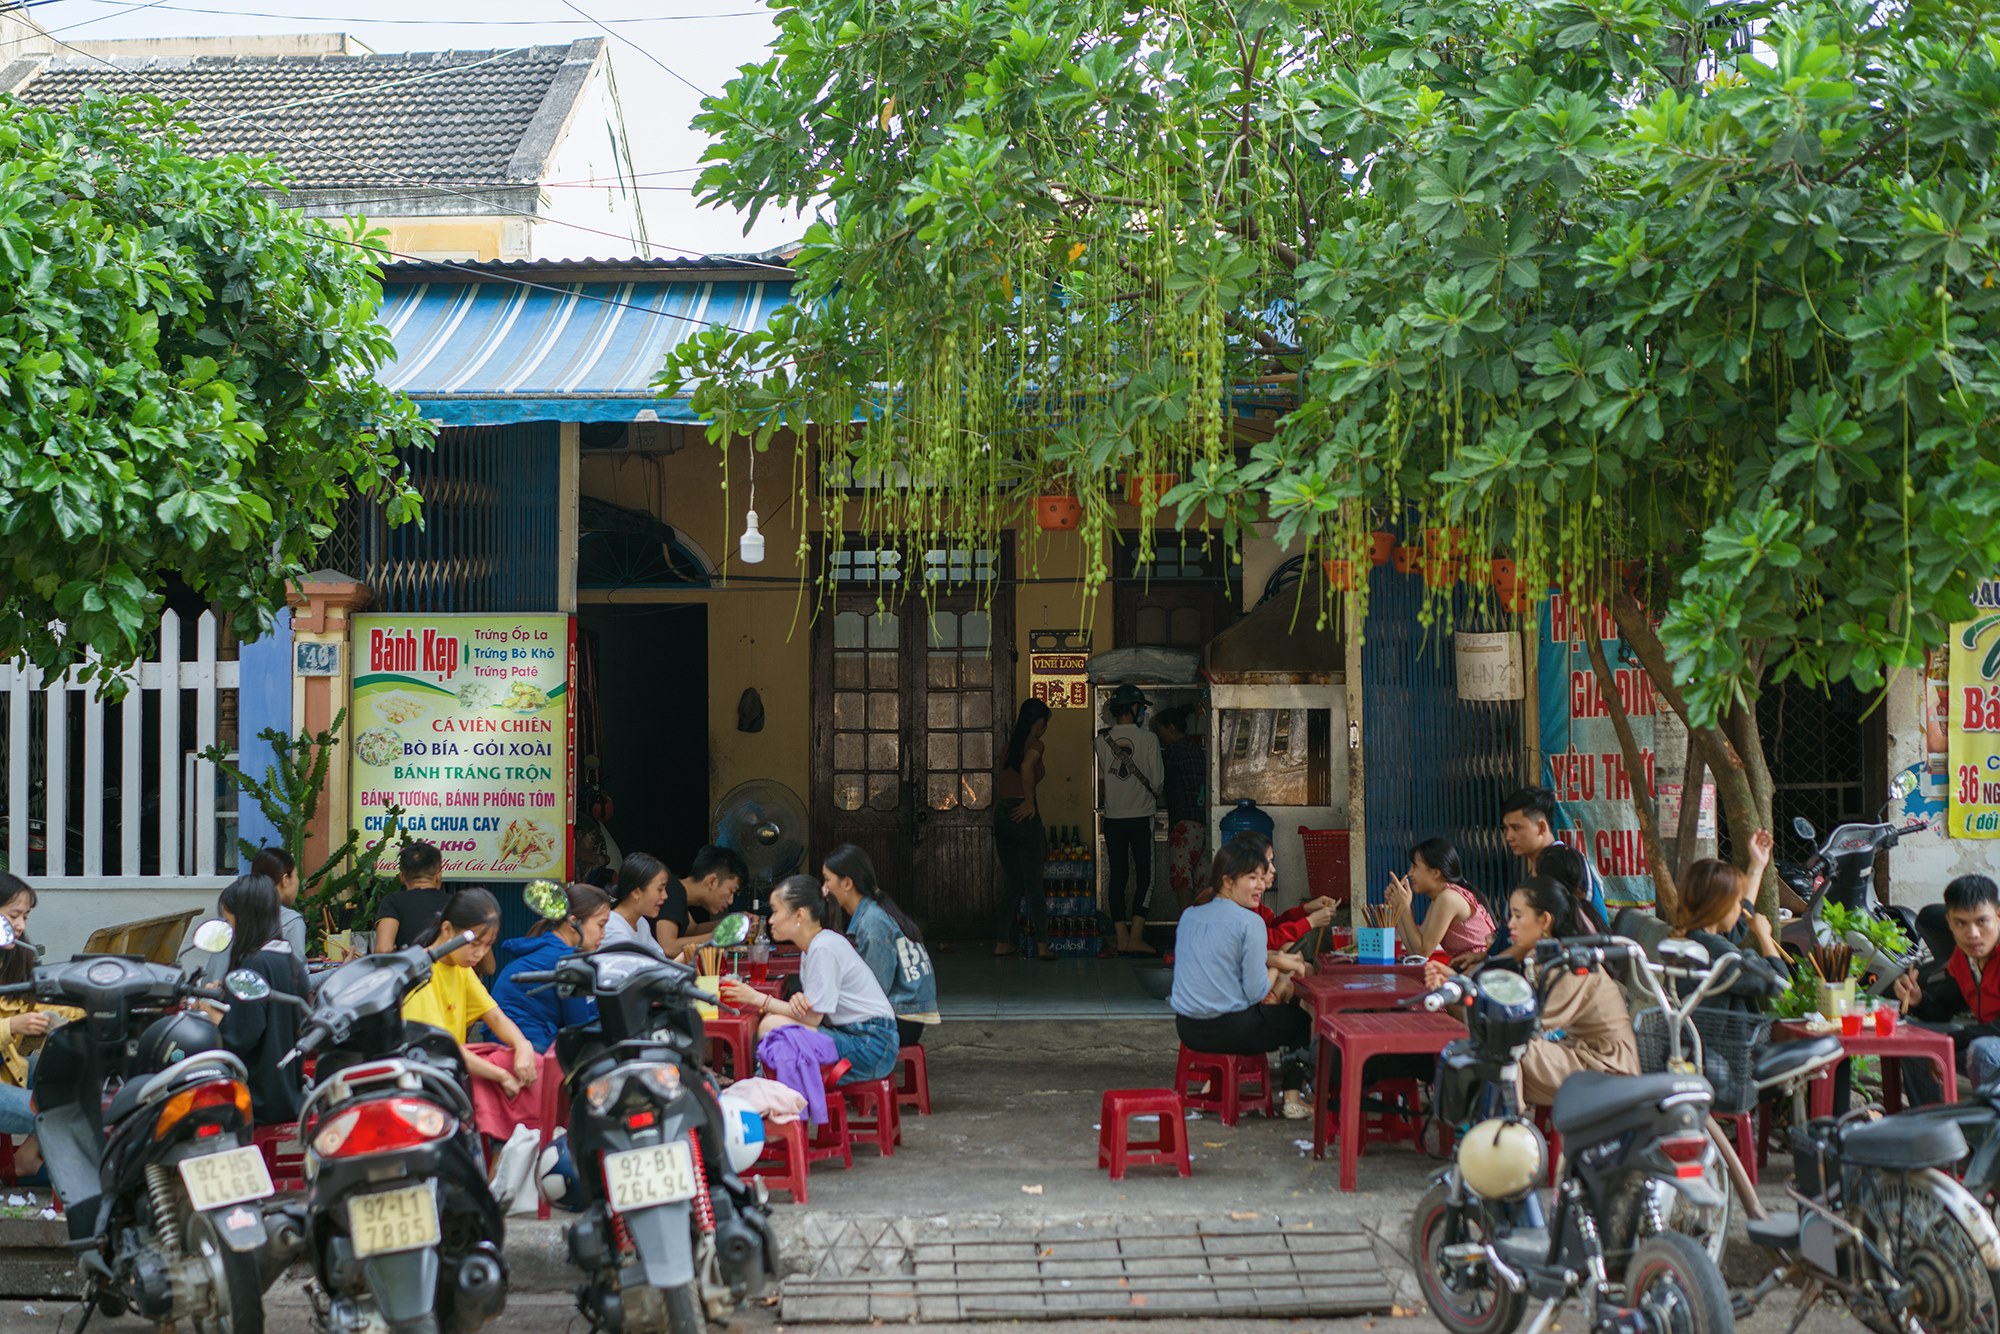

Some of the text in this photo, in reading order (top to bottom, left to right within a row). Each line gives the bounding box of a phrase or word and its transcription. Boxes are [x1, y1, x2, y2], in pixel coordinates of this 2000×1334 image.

[474, 625, 548, 642] Trứng Ốp La
[371, 629, 458, 682] Bánh Kẹp
[474, 647, 555, 661] Trứng Bò Khô
[474, 666, 538, 679] Trứng Patê
[1059, 659, 1085, 669] LONG
[432, 716, 552, 733] CÁ VIÊN CHIÊN
[404, 739, 427, 756] BÒ
[432, 739, 459, 756] BÍA
[473, 739, 504, 756] GỎI
[509, 739, 552, 756] XOÀI
[394, 763, 552, 783] BÁNH TRÁNG TRỘN
[1958, 765, 1979, 805] 36
[361, 788, 395, 807] BÁNH
[398, 790, 442, 808] TƯƠNG,
[446, 788, 480, 807] BÁNH
[529, 788, 555, 807] TÔM
[408, 814, 427, 831] GÀ
[431, 816, 469, 831] CHUA
[473, 816, 500, 831] CAY
[440, 838, 477, 851] KHÔ
[464, 859, 488, 872] Các
[489, 859, 520, 874] Loại
[903, 965, 921, 982] IS
[621, 1148, 676, 1178] 92-B1
[204, 1174, 260, 1203] 4466
[364, 1191, 420, 1222] 92-L1
[366, 1217, 427, 1253] 7885
